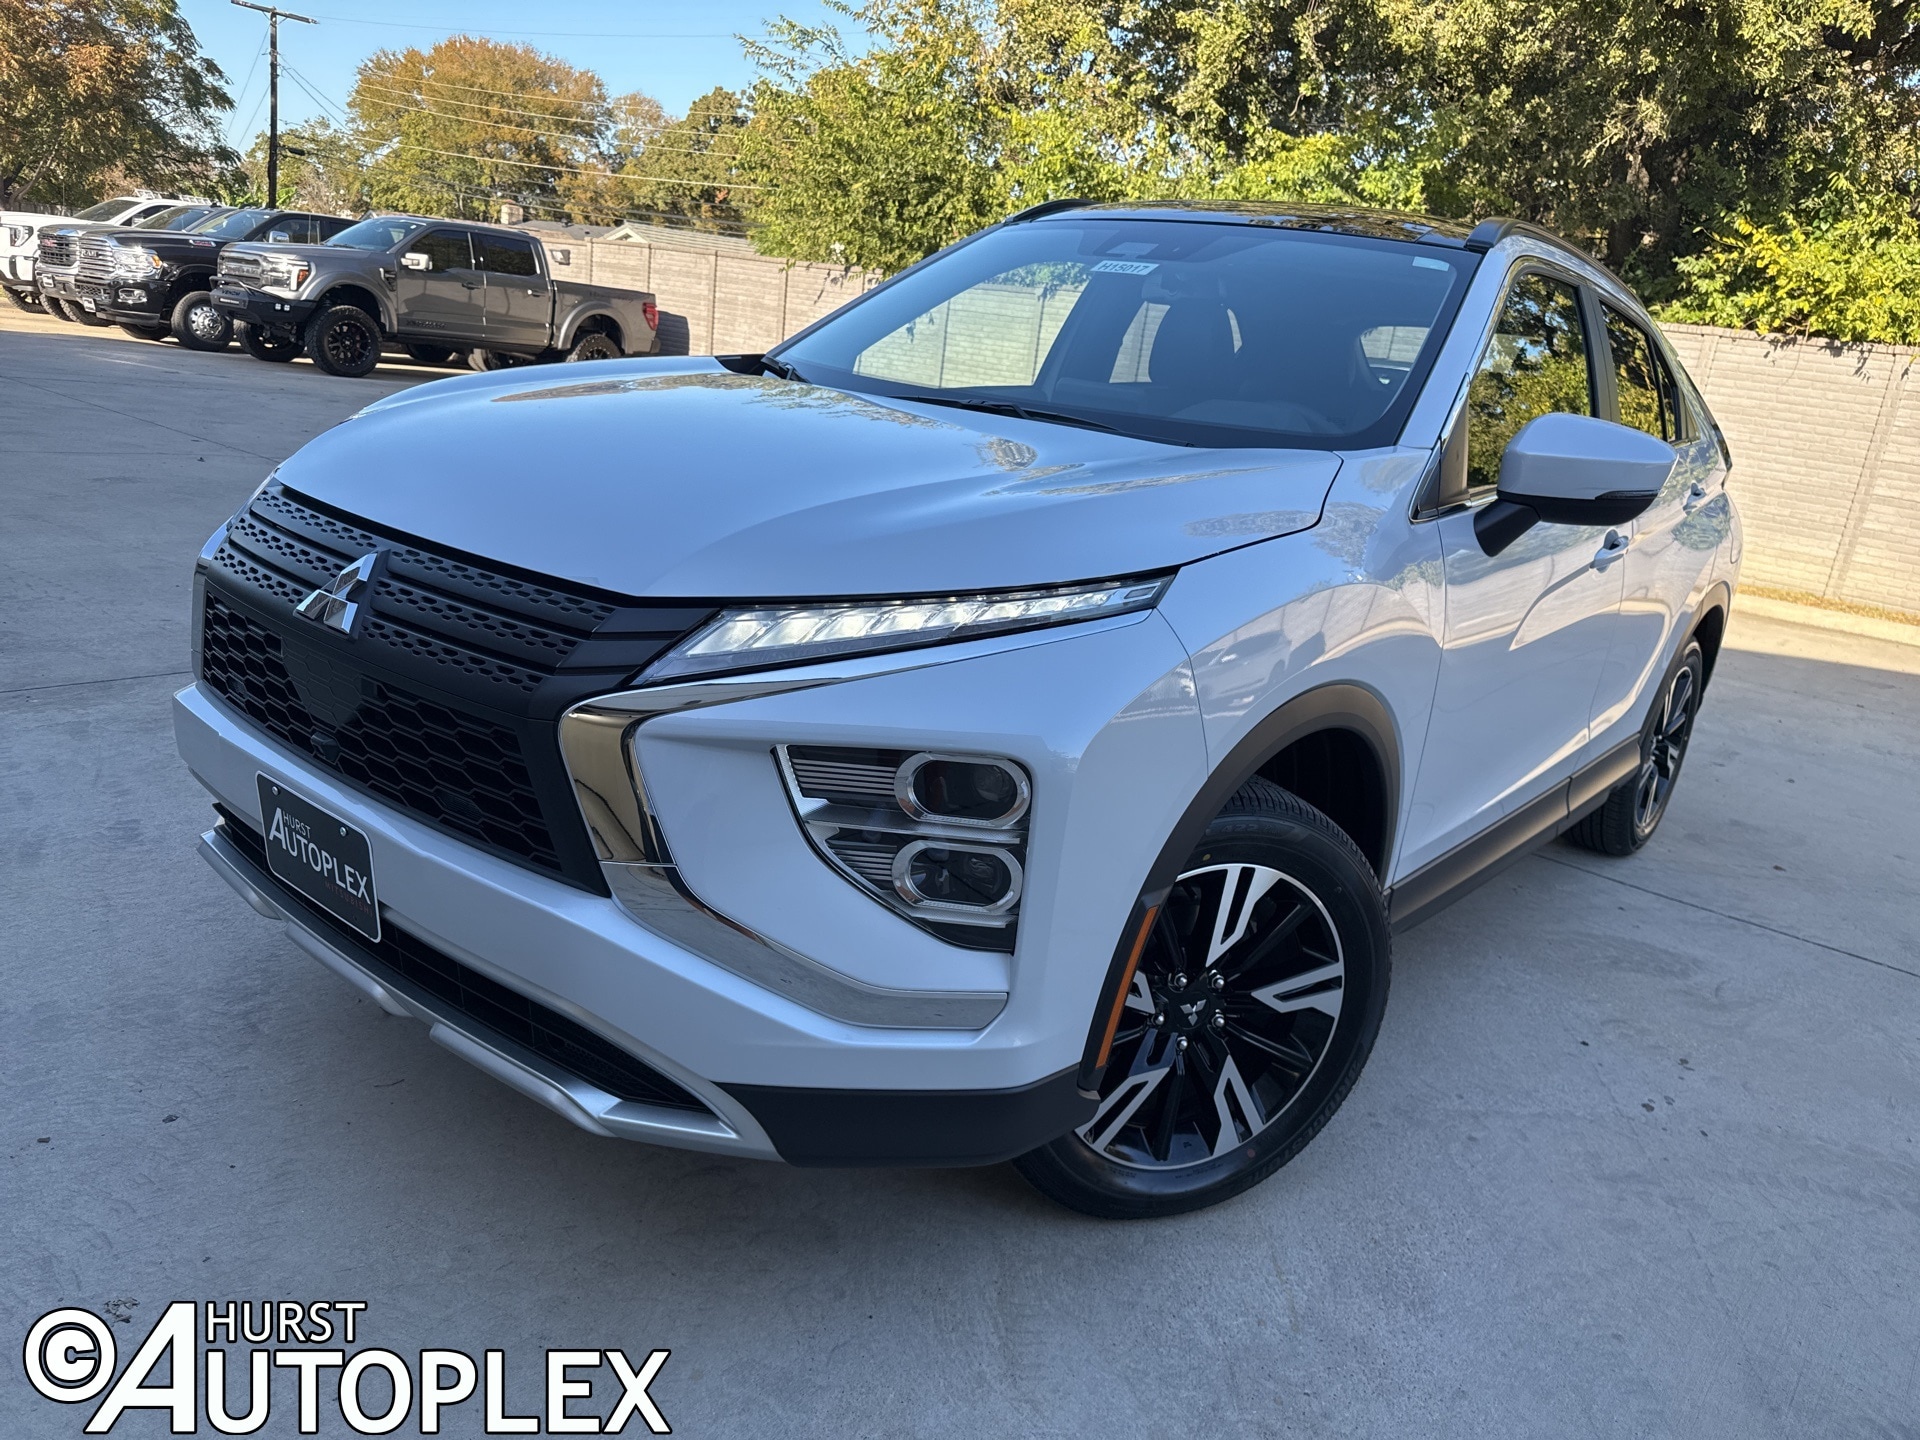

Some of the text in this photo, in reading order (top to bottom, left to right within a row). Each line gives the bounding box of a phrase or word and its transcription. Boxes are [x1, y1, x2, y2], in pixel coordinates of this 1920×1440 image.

[1098, 262, 1150, 273] H15017
[282, 810, 311, 838] HURST
[268, 807, 371, 905] AUTOPLEX
